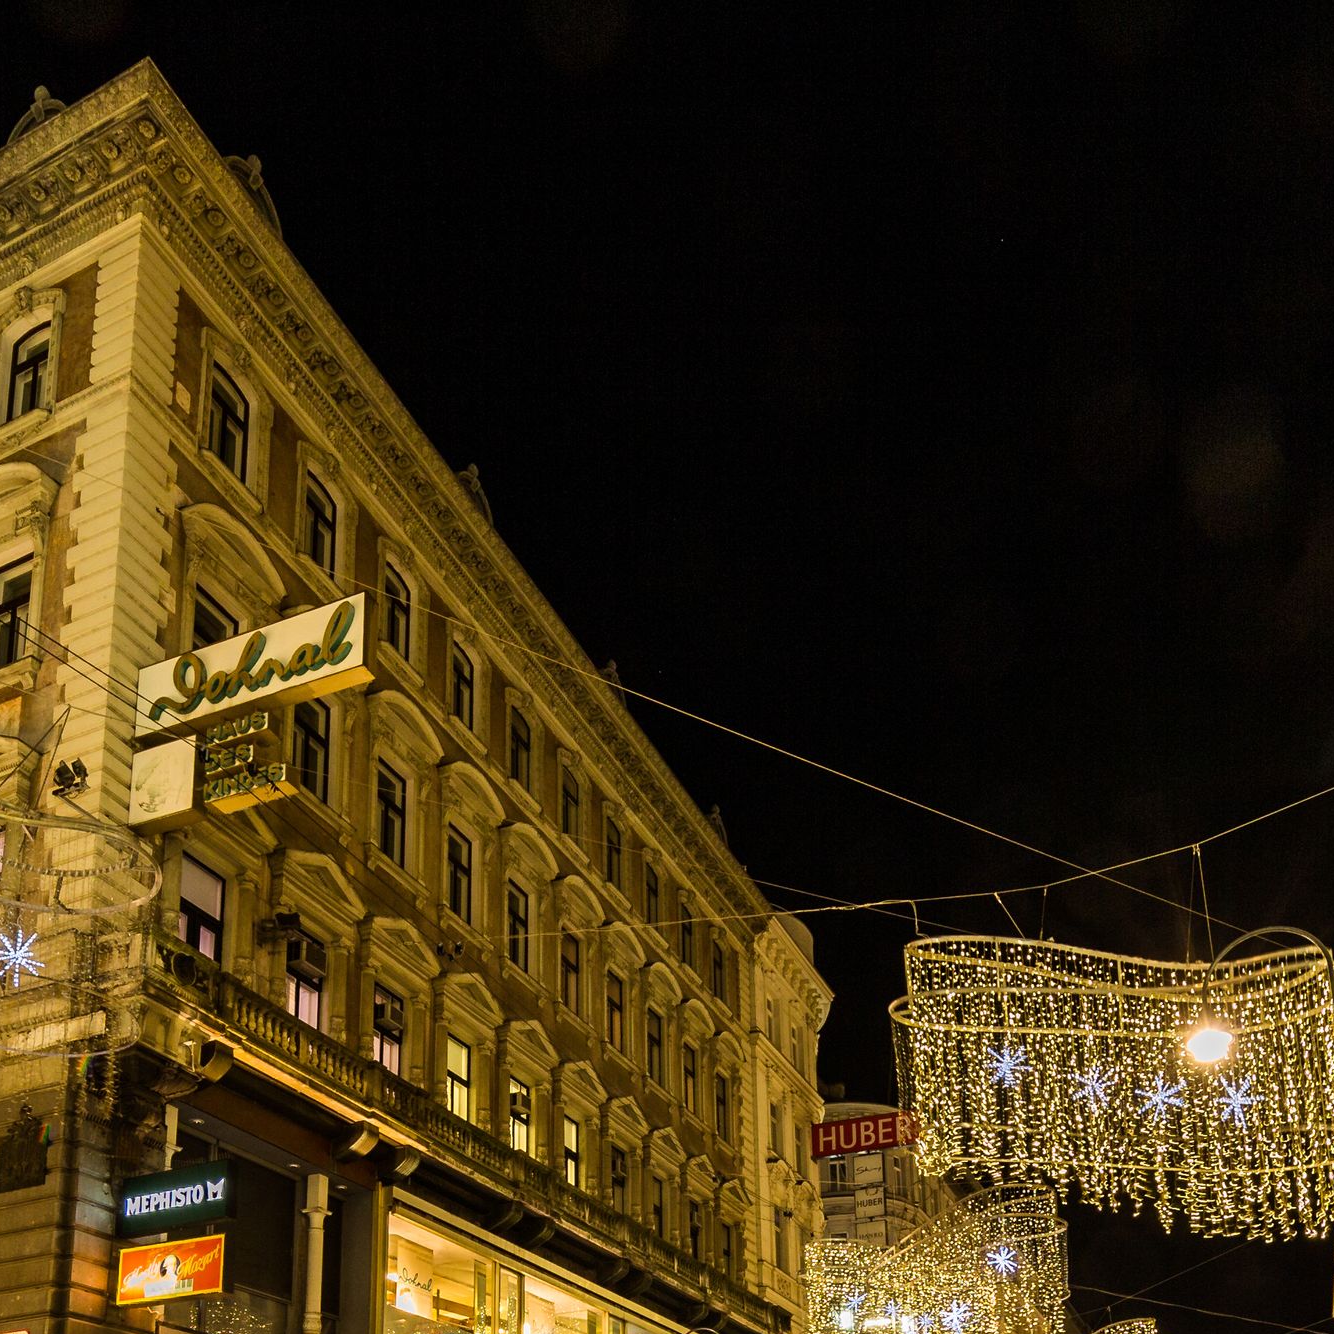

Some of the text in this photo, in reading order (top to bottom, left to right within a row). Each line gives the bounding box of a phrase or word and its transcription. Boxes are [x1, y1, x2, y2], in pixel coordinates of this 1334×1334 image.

[149, 600, 355, 721] Dohnal
[206, 711, 267, 742] HAUS
[819, 1115, 913, 1152] HUBER
[126, 1184, 205, 1216] MEPHISTO
[856, 1197, 883, 1208] HUBER
